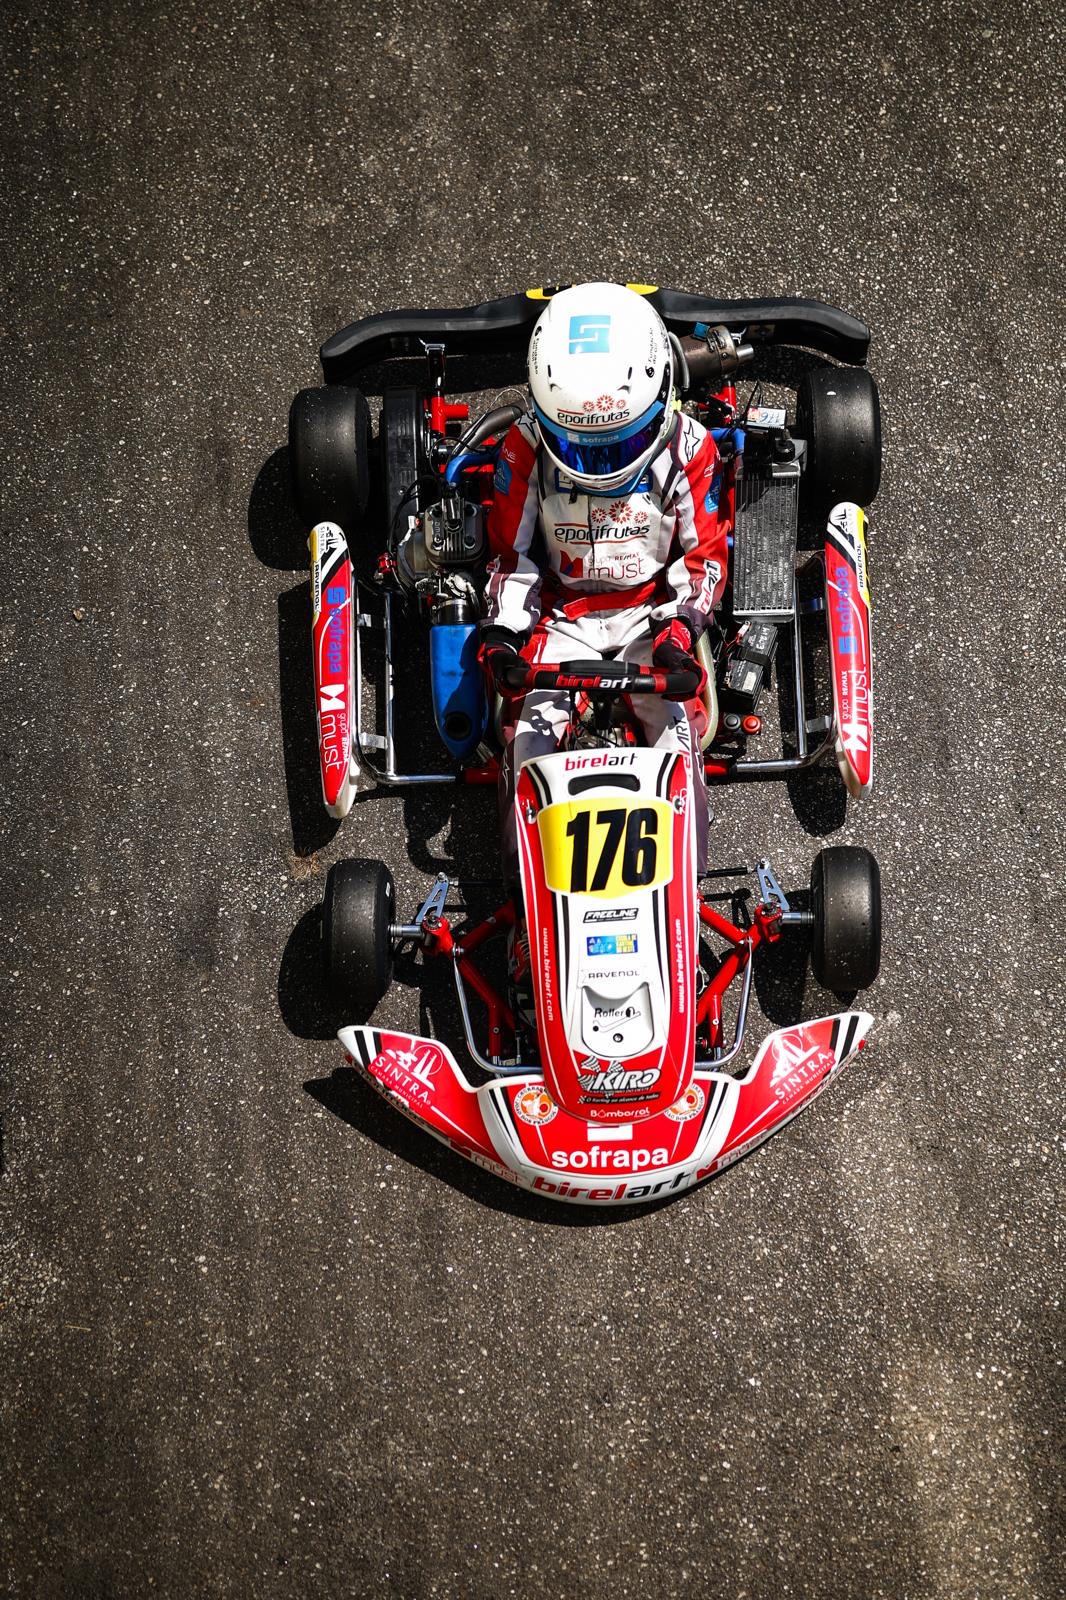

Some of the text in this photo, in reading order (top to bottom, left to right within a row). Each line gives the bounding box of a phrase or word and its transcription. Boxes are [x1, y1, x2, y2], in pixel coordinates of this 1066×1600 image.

[557, 409, 630, 425] eporifrutas
[582, 434, 620, 444] sofrapa
[554, 524, 650, 543] eporifrutas
[587, 558, 646, 581] must
[835, 567, 855, 633] sofrapa
[327, 607, 345, 673] sofrapa
[555, 674, 632, 689] birelart
[848, 665, 867, 723] must
[842, 699, 852, 720] grupo
[337, 713, 348, 734] grupo
[322, 713, 343, 774] must
[565, 753, 639, 771] birelart
[566, 808, 658, 893] 176
[585, 909, 638, 920] FREELINE
[543, 927, 554, 1021] www.birelart.com
[589, 970, 640, 979] RAVENOL
[674, 918, 684, 1013] www.birelart.com
[374, 1055, 429, 1103] SINTRA
[590, 1068, 661, 1091] KIRO
[775, 1052, 830, 1100] SINTRA
[551, 1145, 669, 1170] sofrapa
[534, 1171, 691, 1200] birelart
